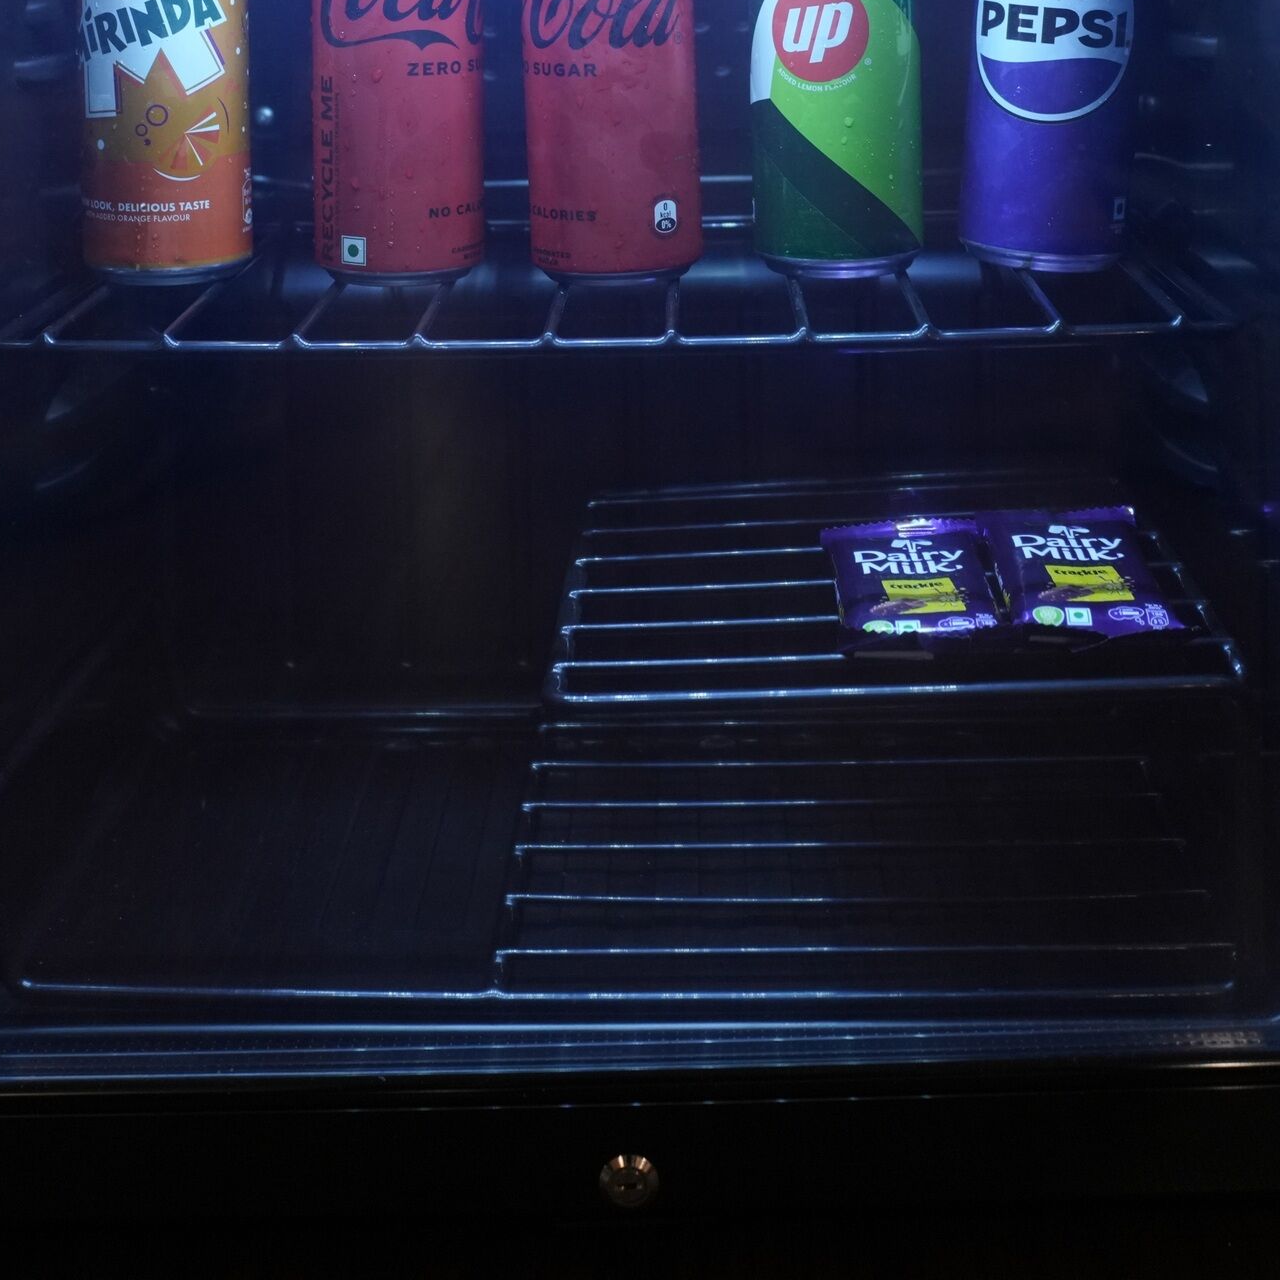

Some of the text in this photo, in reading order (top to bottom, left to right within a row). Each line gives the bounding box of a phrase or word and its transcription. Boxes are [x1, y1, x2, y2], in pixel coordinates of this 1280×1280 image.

[981, 0, 1128, 48] PEPSI
[407, 61, 462, 76] ZERO
[533, 62, 598, 77] SUGAR
[778, 67, 858, 93] ADDED LEMON FLAVOUR
[321, 75, 334, 262] RECYCLE ME
[118, 202, 176, 213] DELICIOUS
[178, 199, 210, 211] TASTE
[429, 206, 451, 218] NO
[531, 204, 597, 221] CALORIES
[117, 214, 151, 223] ORANGE
[153, 214, 191, 222] FLAVOUR
[1011, 534, 1122, 550] Dairy
[853, 550, 964, 564] Dairy
[1022, 546, 1125, 561] Milk
[861, 561, 964, 575] Milk
